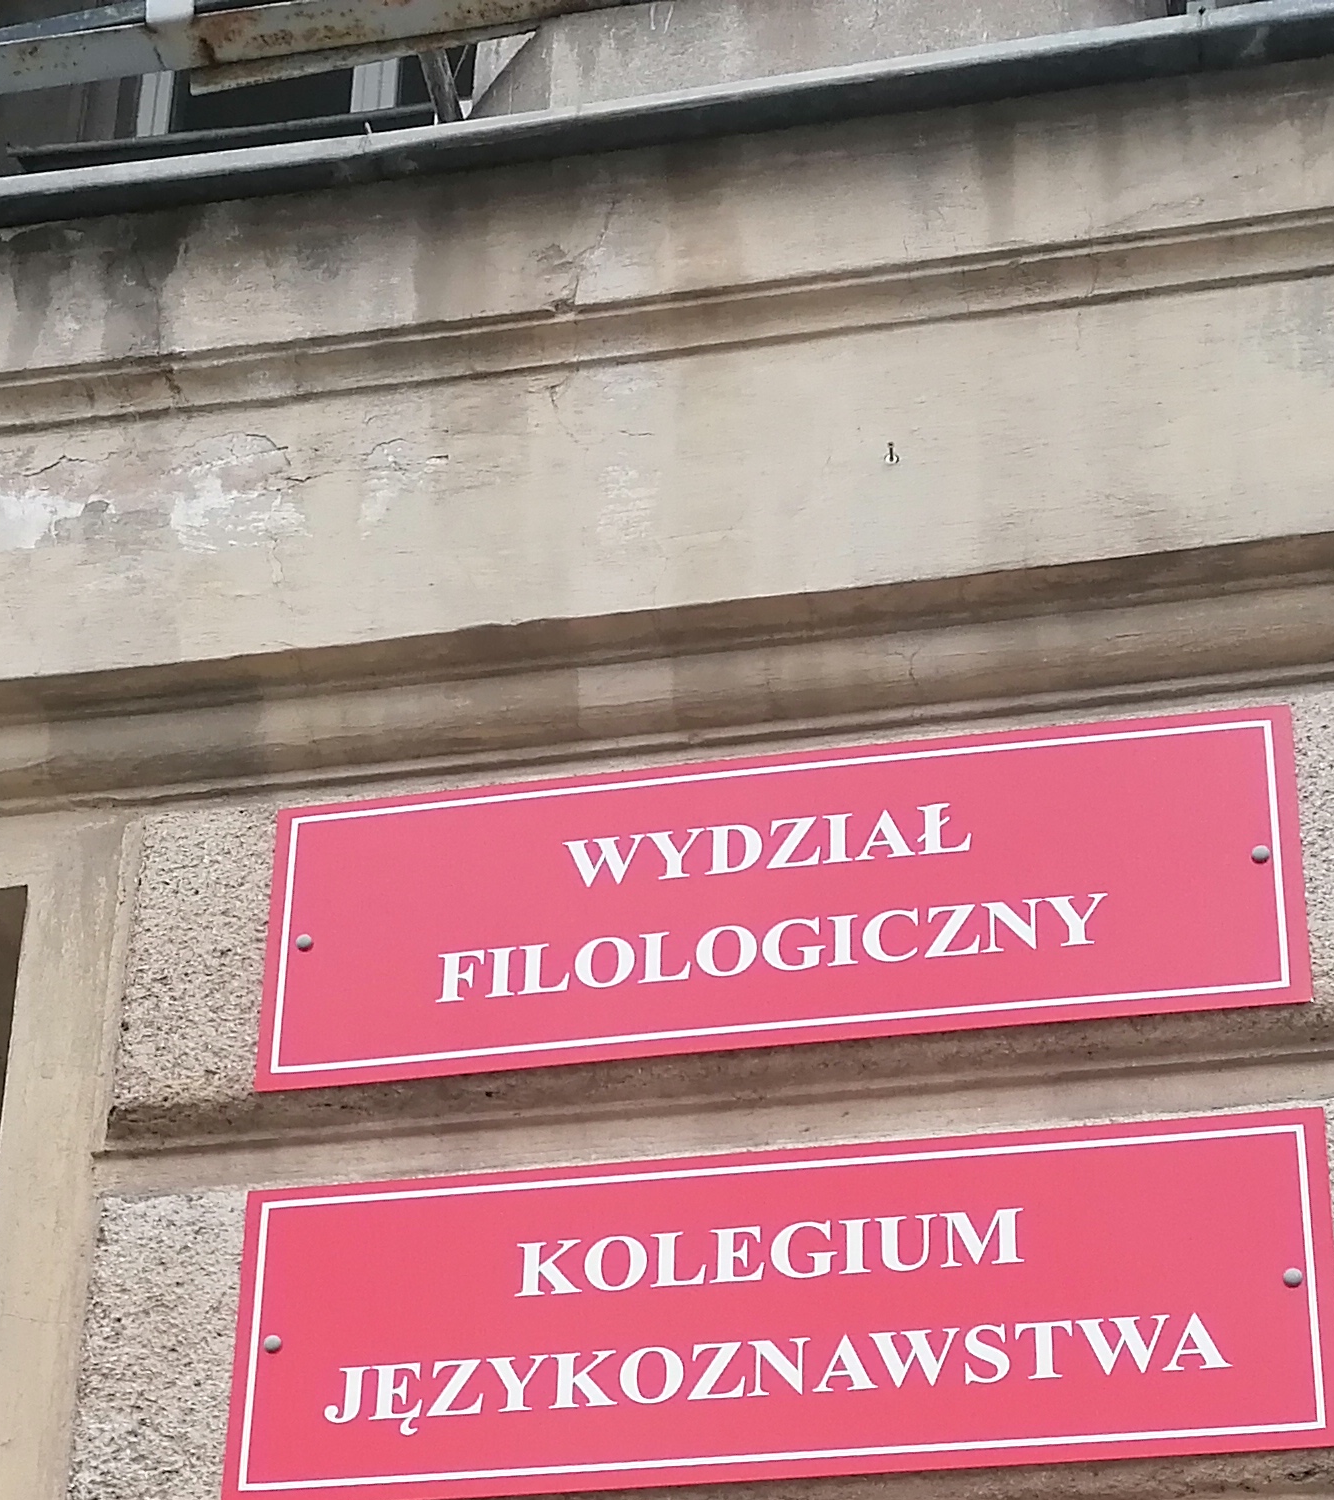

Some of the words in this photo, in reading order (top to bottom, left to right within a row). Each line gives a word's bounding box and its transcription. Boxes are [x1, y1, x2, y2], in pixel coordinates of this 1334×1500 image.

[562, 802, 973, 888] WYDZIAŁ
[435, 891, 1109, 1004] FILOLOGICZNY
[514, 1207, 1025, 1297] KOLEGIUM
[323, 1312, 1232, 1437] JĘZYKOZNAWSTWA
